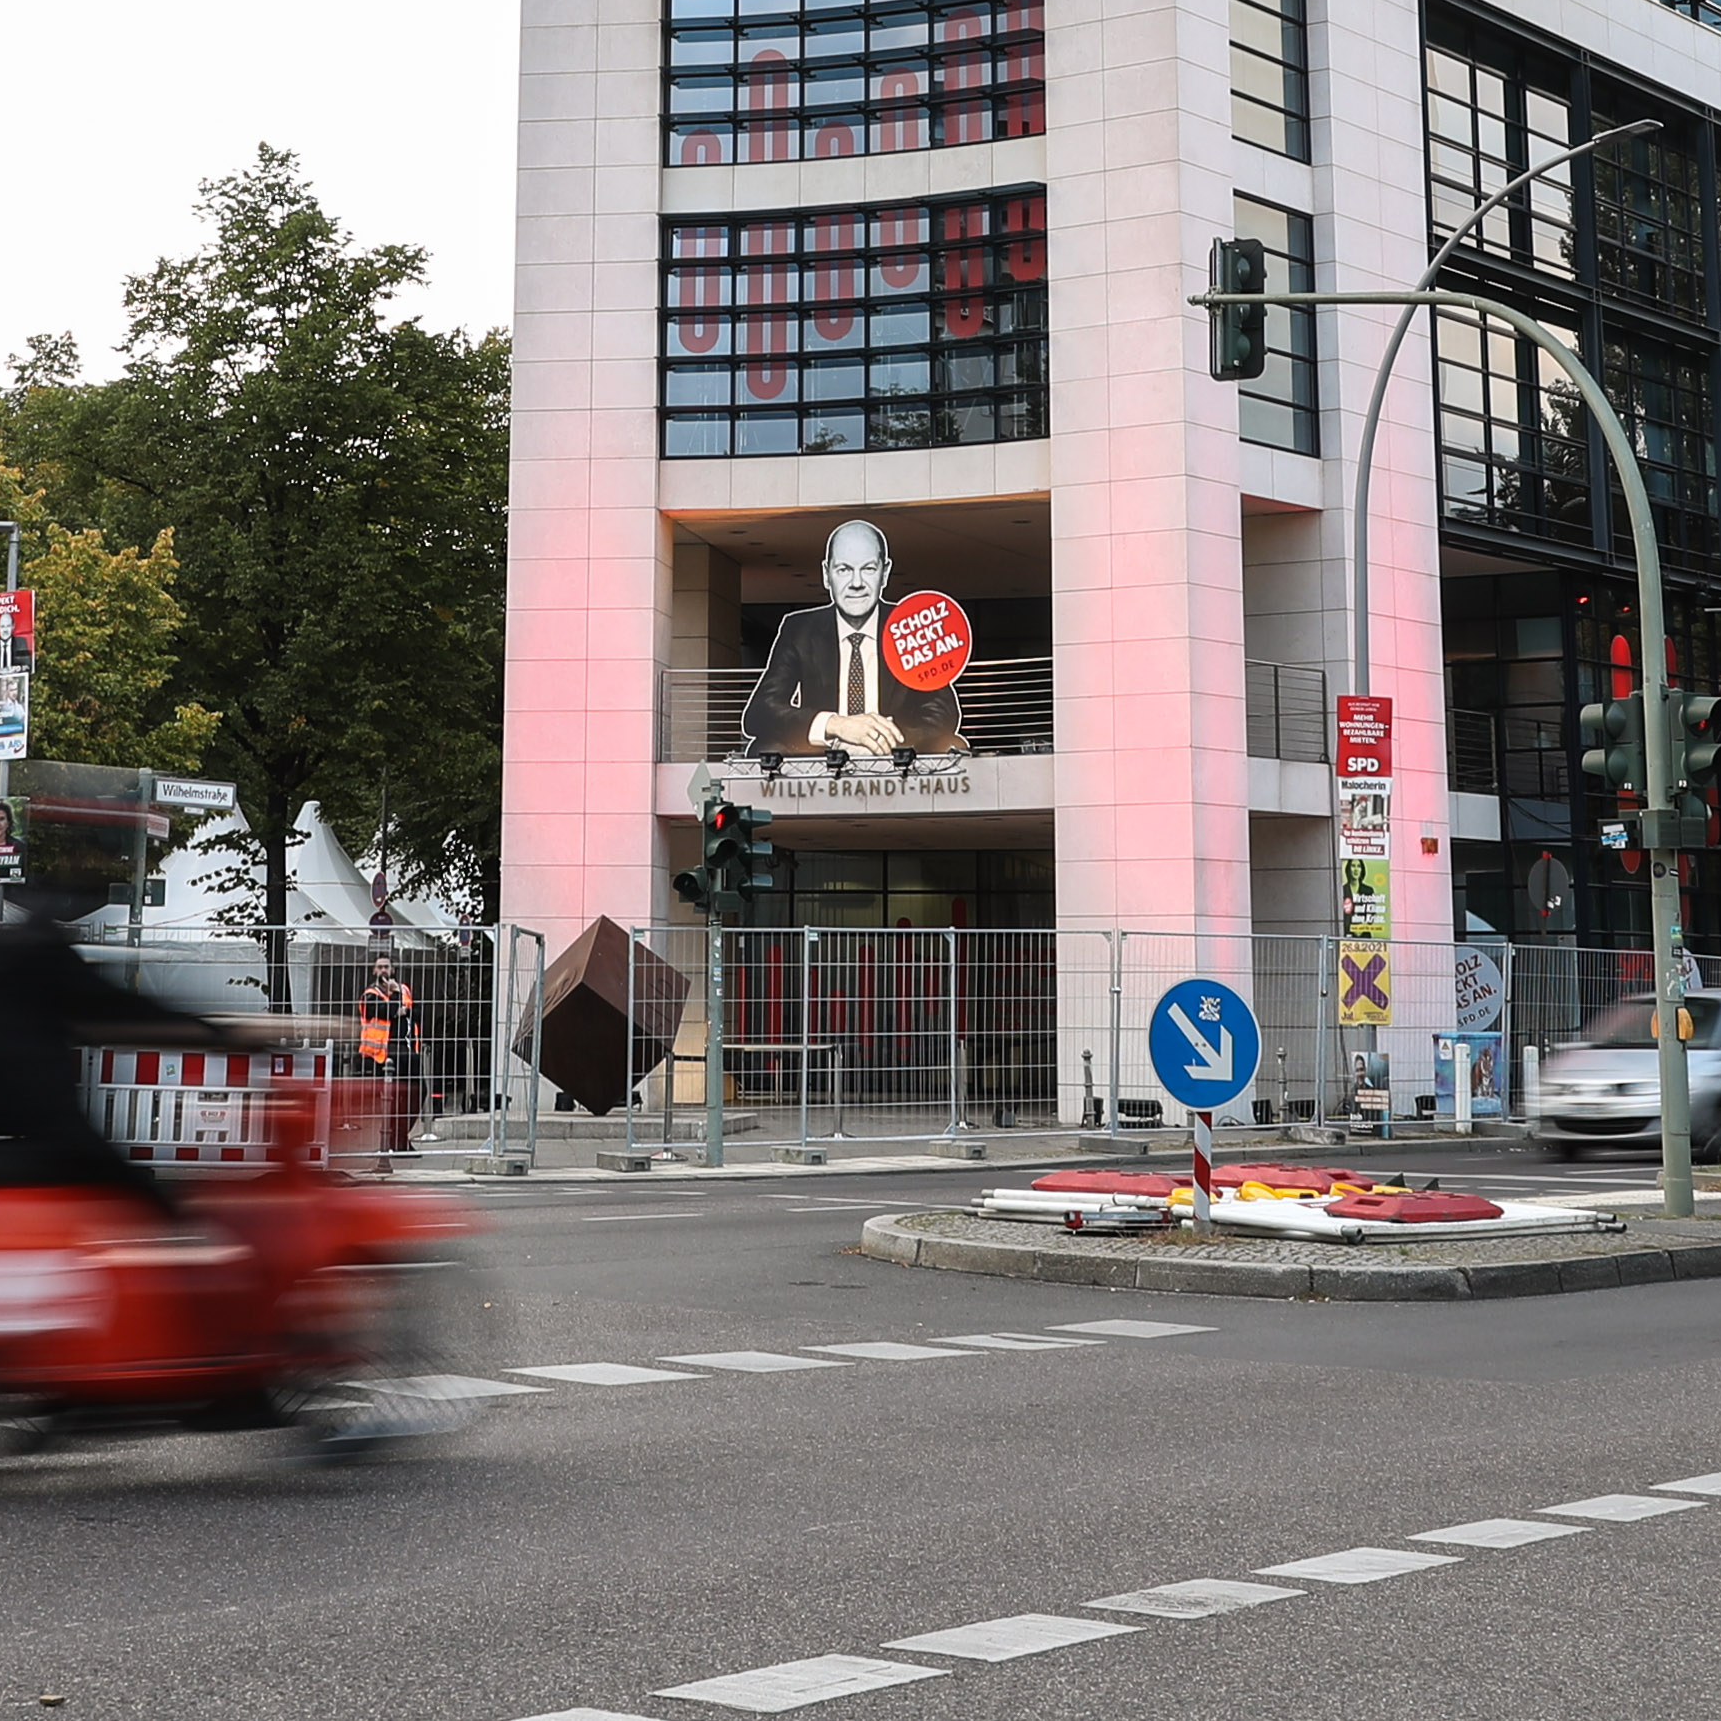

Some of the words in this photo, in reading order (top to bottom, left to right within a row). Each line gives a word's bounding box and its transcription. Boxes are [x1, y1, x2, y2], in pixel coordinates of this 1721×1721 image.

[0, 604, 20, 615] DICH.
[889, 600, 951, 640] SCHOLZ
[895, 620, 945, 655] PACKT
[900, 644, 934, 672] DAS
[935, 634, 964, 662] AN.
[917, 659, 955, 683] SPD.DE
[1353, 713, 1374, 721] MEHR
[1343, 729, 1384, 737] BEZAHLBARE
[1349, 736, 1377, 744] MIETEN.
[1347, 757, 1379, 772] SPD
[163, 783, 228, 804] Wilhelmstraße
[761, 775, 972, 798] WILLY-BRANDT-HAUS
[1341, 780, 1386, 791] Malocherin
[1352, 892, 1386, 903] Wirtschaft
[1342, 941, 1387, 952] 26.9.2021
[1473, 982, 1497, 1004] AN.
[1458, 1006, 1491, 1028] SPD.DE
